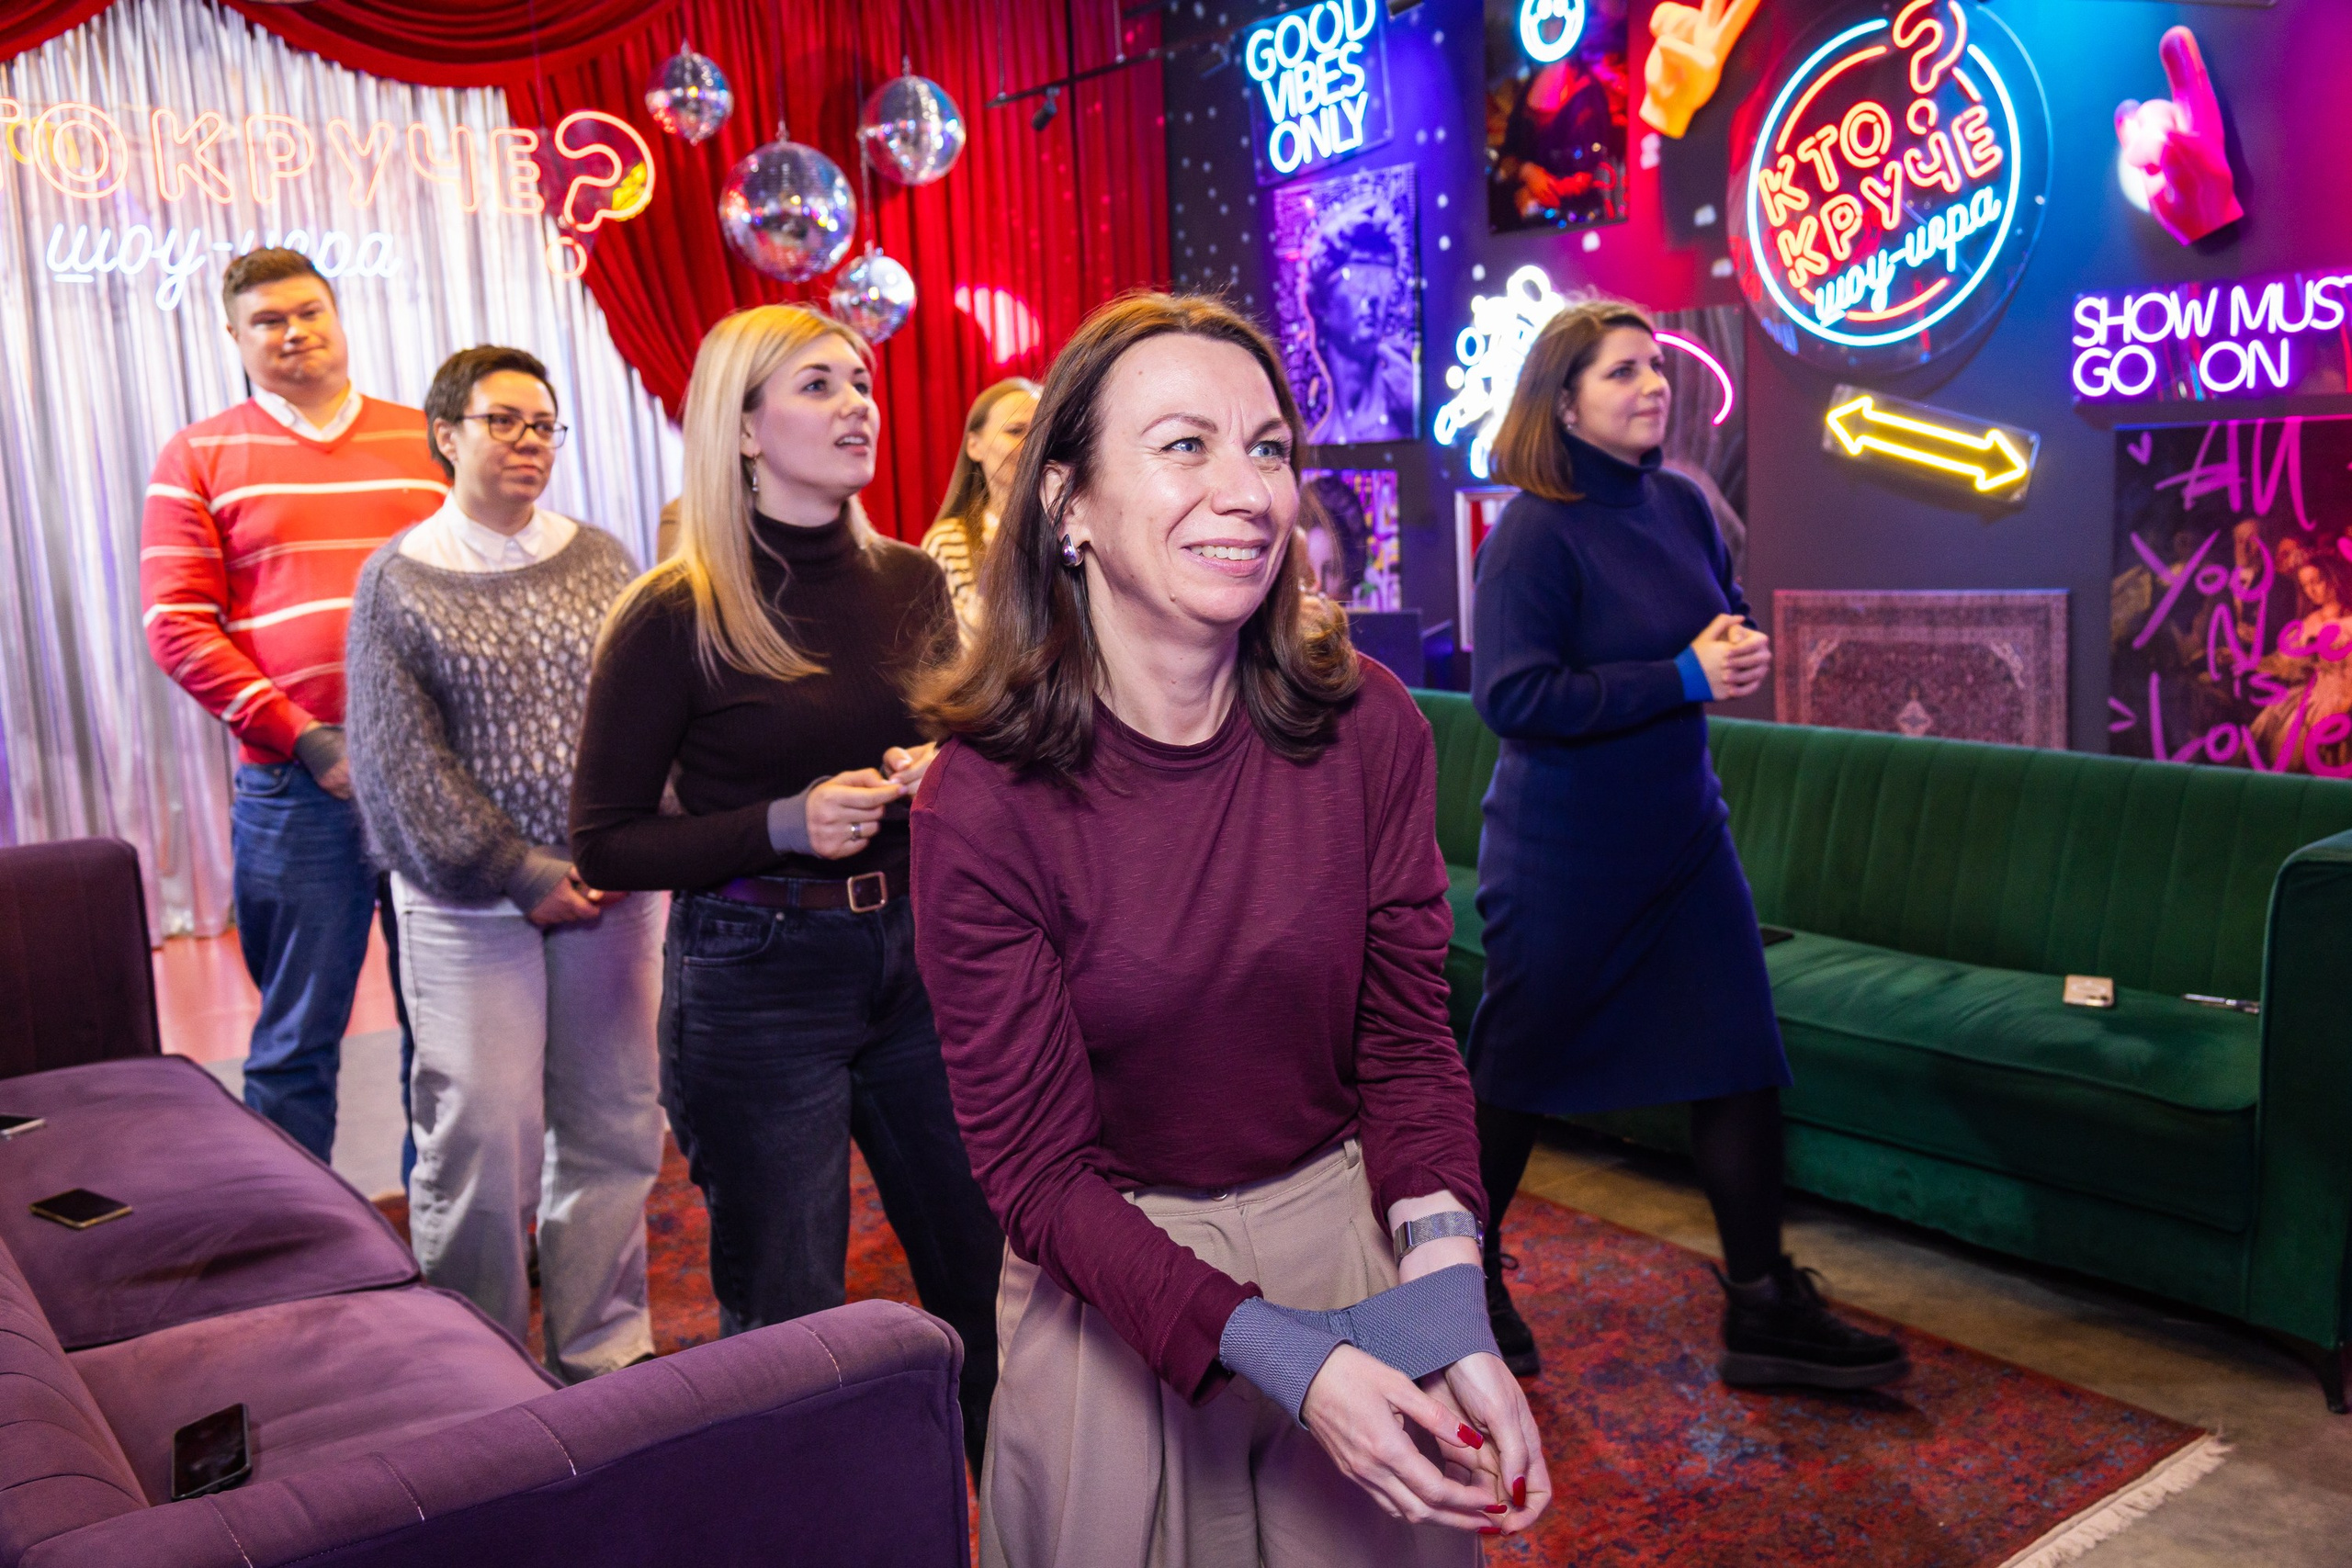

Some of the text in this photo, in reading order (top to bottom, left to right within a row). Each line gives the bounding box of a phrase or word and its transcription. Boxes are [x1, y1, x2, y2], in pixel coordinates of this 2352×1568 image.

[1245, 0, 1376, 82] GOOD
[1261, 41, 1366, 124] VIBES
[1269, 90, 1369, 174] ONLY
[1758, 101, 1893, 227] КТО
[150, 107, 656, 279] КРУЧЕ?
[1776, 105, 2004, 288] КРУЧЕ
[1815, 186, 2002, 327] шоу-игра
[2072, 287, 2219, 348] SHOW
[2072, 337, 2290, 397] GO ON
